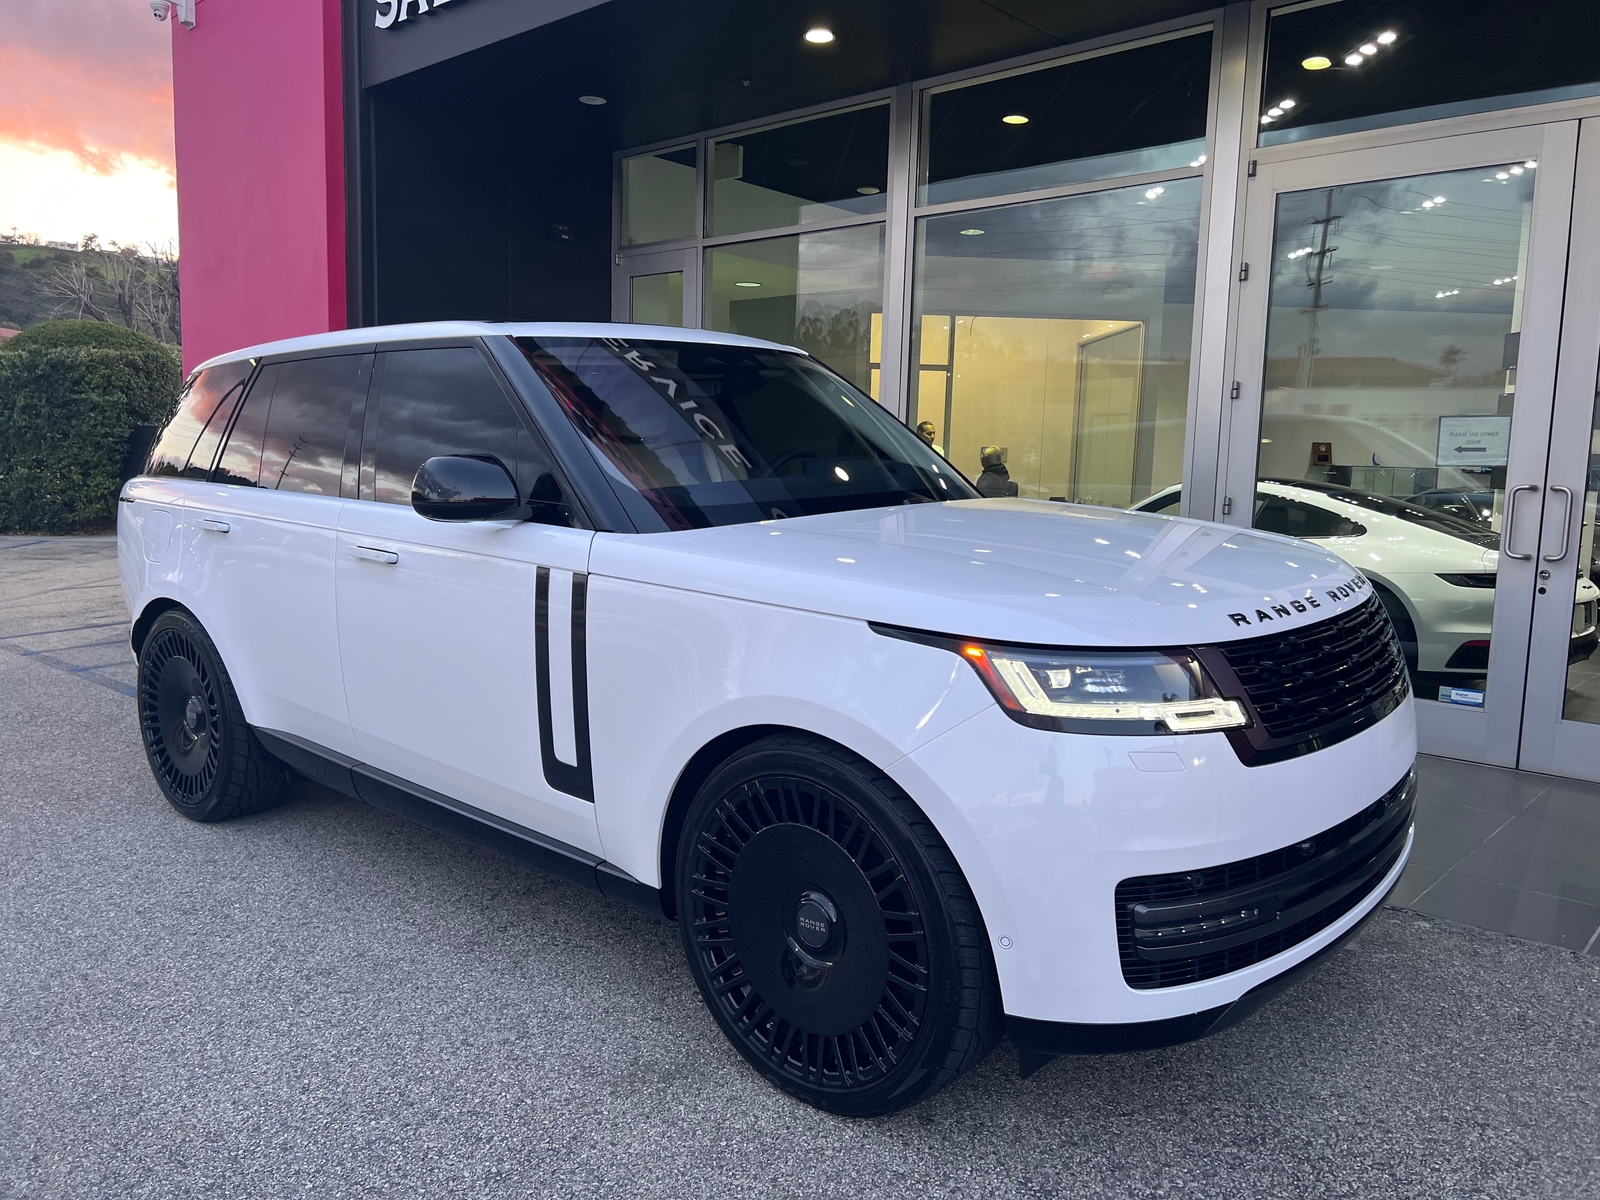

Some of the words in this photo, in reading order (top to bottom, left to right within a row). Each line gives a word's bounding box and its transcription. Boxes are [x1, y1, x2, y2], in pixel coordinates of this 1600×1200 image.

[1227, 595, 1322, 627] RANGE
[1325, 574, 1366, 603] ROVER
[799, 917, 826, 928] RANGE
[800, 922, 826, 933] ROVER
